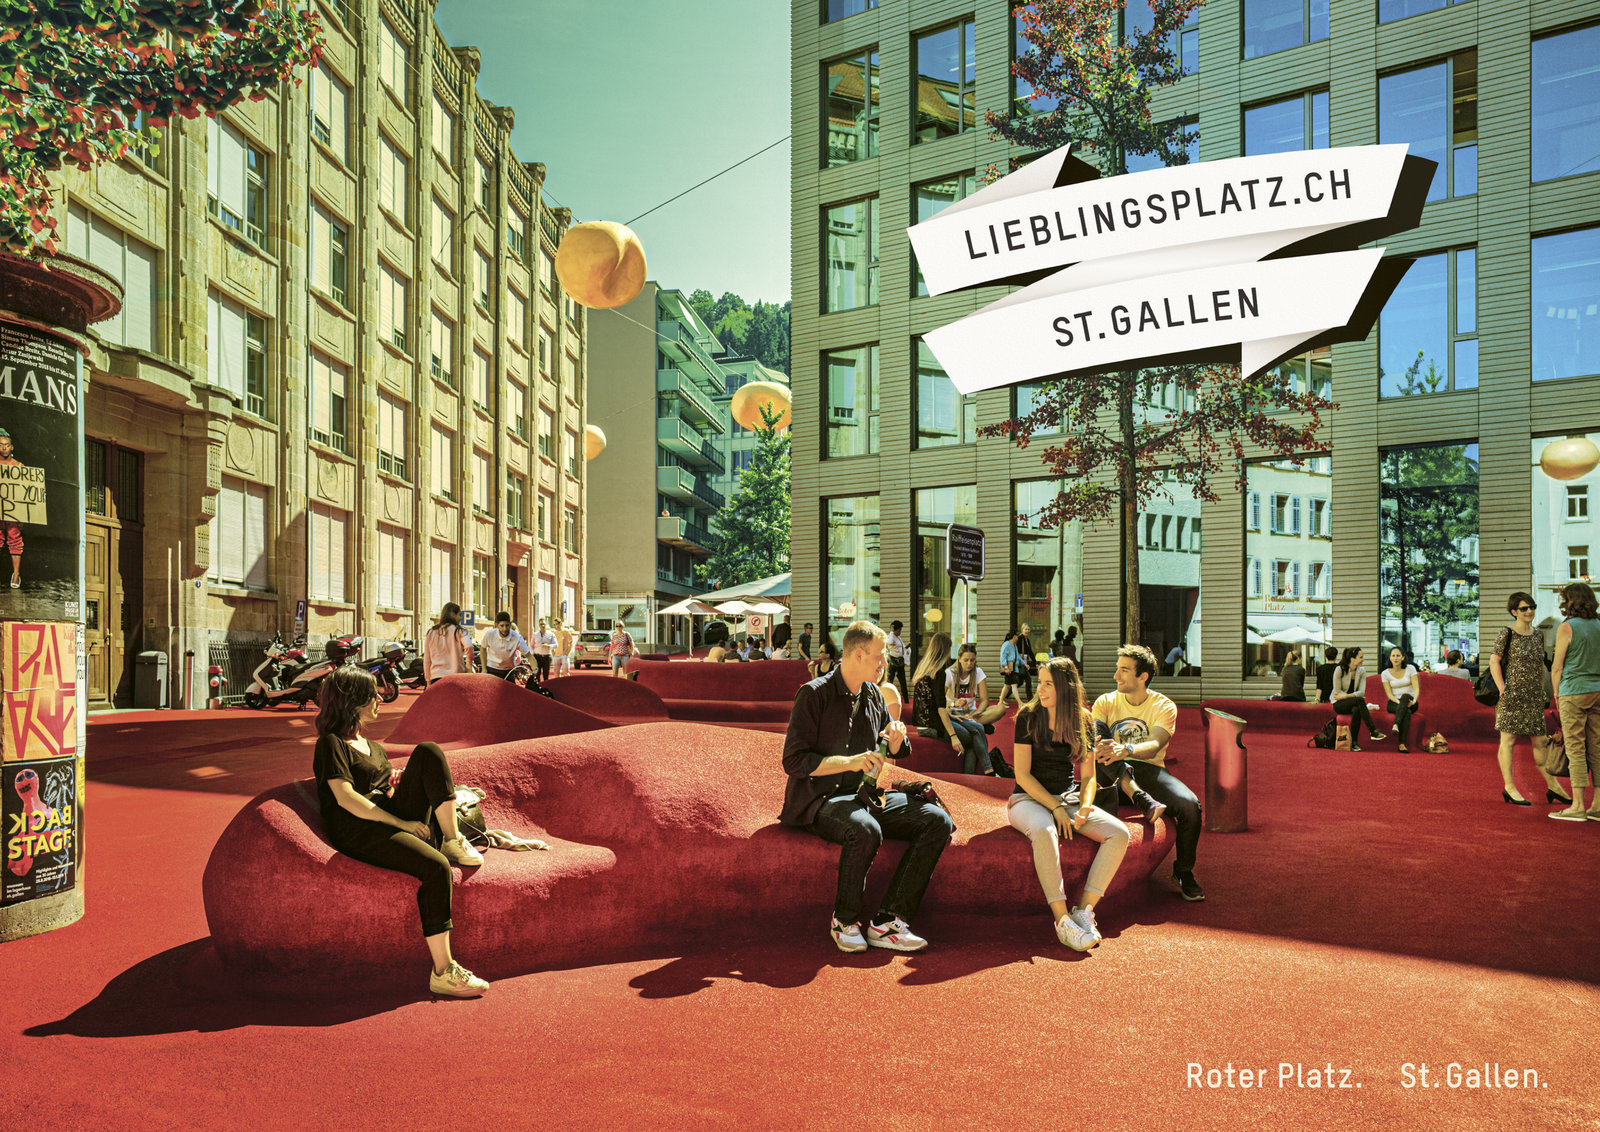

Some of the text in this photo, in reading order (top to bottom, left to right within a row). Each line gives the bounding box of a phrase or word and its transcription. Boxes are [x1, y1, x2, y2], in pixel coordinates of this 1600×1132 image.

[1, 327, 29, 338] Francesco
[1, 334, 20, 342] Simon
[10, 355, 38, 367] September
[298, 603, 304, 614] P
[463, 612, 472, 624] P
[7, 828, 72, 859] STAGE
